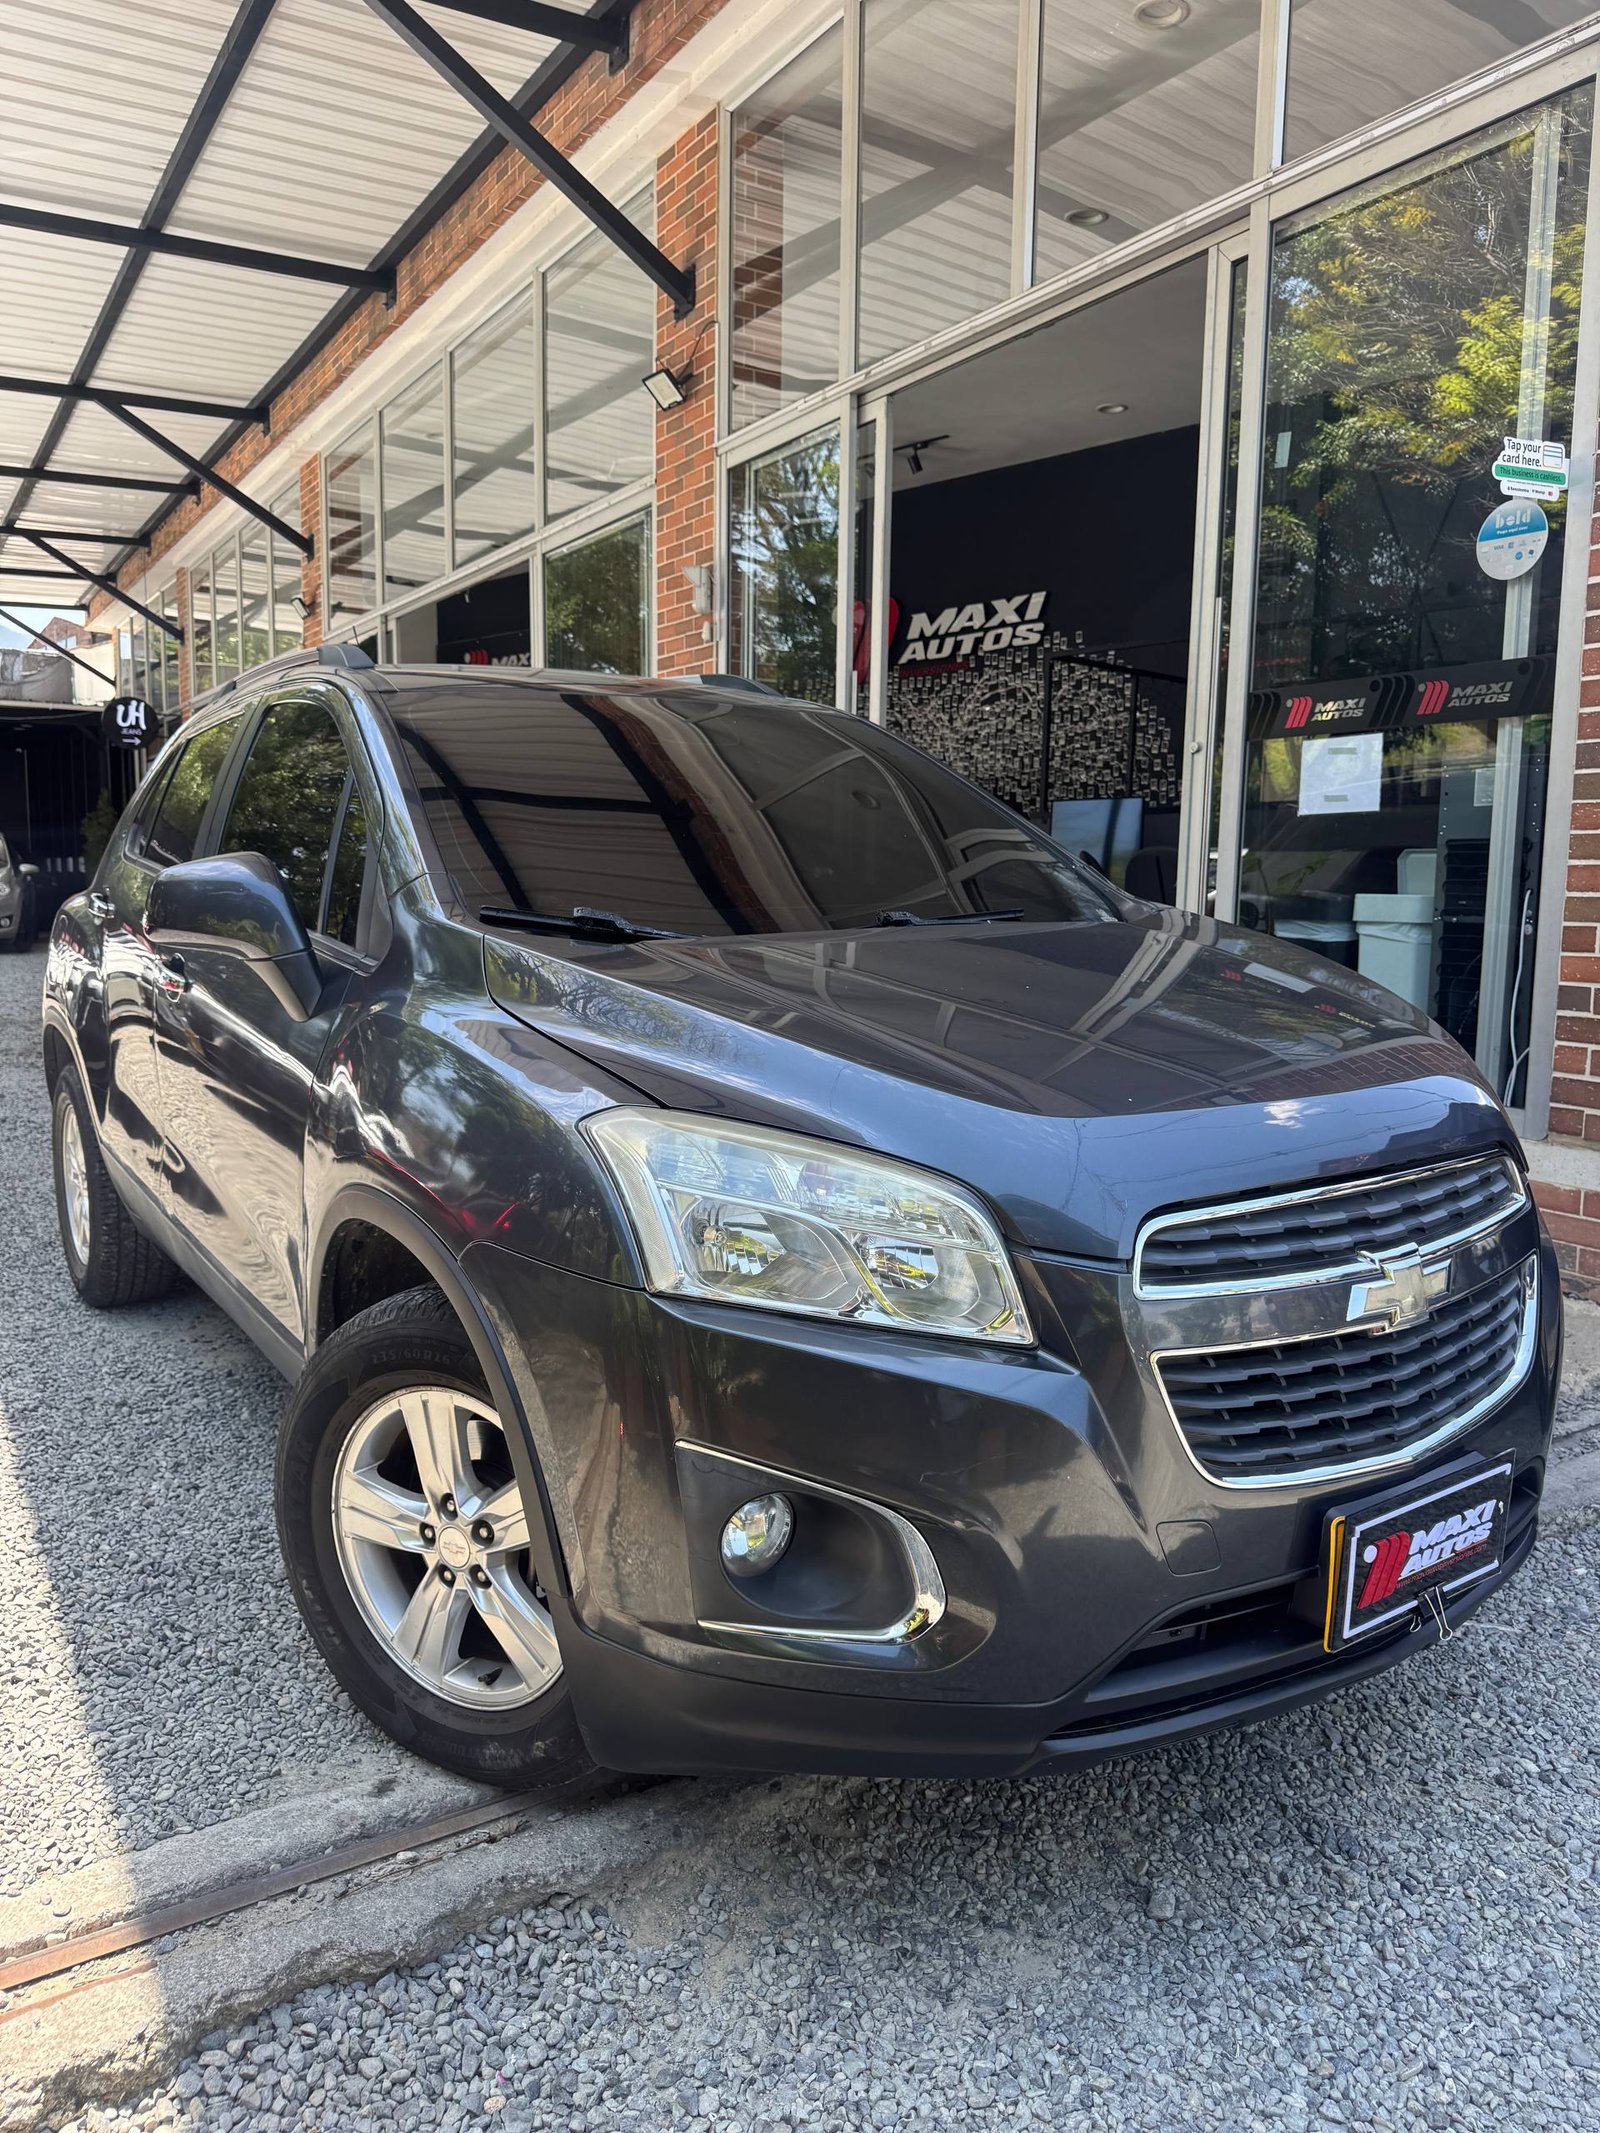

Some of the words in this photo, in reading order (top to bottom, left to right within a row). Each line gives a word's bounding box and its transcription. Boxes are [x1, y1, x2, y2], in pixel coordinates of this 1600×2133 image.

[1507, 439, 1521, 452] Tap
[1523, 443, 1541, 453] your
[1502, 454, 1520, 464] card
[1522, 455, 1541, 467] here.
[1500, 466, 1511, 475] This
[1512, 469, 1533, 478] business
[1540, 473, 1562, 481] cashless.
[1495, 508, 1531, 529] bold
[906, 591, 1047, 640] MAXI
[898, 622, 1045, 664] AUTOS
[491, 652, 530, 666] MAX
[1451, 681, 1513, 698] MAXI
[1314, 697, 1366, 713] MAXI
[1447, 693, 1511, 707] AUTOS
[116, 700, 147, 730] UH
[1311, 708, 1364, 721] AUTOS
[1408, 1499, 1497, 1555] MAXI
[1400, 1522, 1493, 1577] AUTOS
